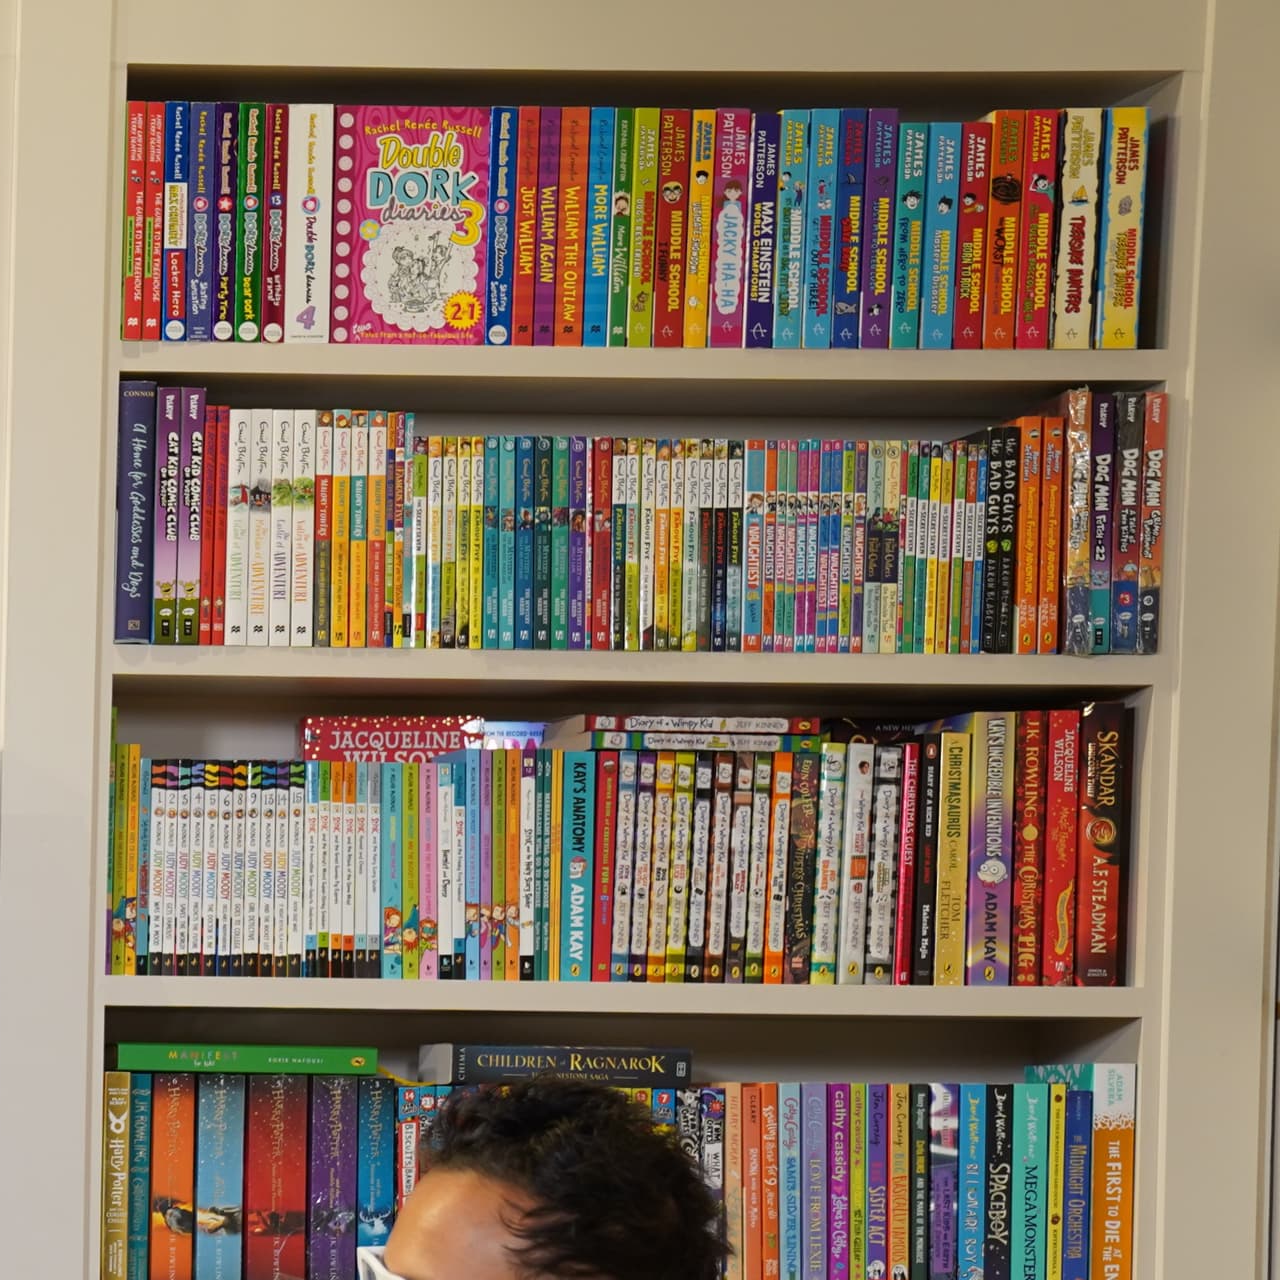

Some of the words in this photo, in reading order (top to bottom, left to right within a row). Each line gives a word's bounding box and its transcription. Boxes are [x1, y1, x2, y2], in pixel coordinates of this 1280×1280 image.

[378, 134, 461, 168] Double
[370, 171, 476, 207] DORK
[383, 199, 464, 221] diaries
[761, 202, 773, 234] MAX
[1036, 213, 1049, 259] MIDDLE
[171, 252, 179, 288] Locker
[564, 243, 578, 266] THE
[758, 238, 772, 303] EINSTEIN
[562, 271, 576, 321] OUTLAW
[1035, 263, 1047, 310] SCHOOL
[172, 291, 180, 316] Hero
[133, 423, 147, 432] A
[132, 438, 148, 469] Home
[1005, 438, 1016, 455] the
[128, 472, 147, 488] for
[1004, 460, 1016, 490] BAD
[1094, 454, 1111, 482] DOG
[1001, 493, 1015, 533] GUYS
[1095, 484, 1110, 511] MAN
[130, 492, 147, 544] Goddesses
[731, 512, 739, 544] FAMOUS
[130, 546, 143, 569] and
[731, 546, 739, 564] FIVE
[747, 526, 760, 586] NAUGHTIEST
[122, 571, 142, 598] Dogs
[329, 730, 460, 750] JACQUELINE
[573, 762, 587, 794] KAY'S
[908, 758, 916, 777] THE
[905, 779, 916, 834] CHRISTMAS
[572, 797, 587, 853] ANATOMY
[904, 836, 914, 866] GUEST
[570, 883, 585, 928] ADAM
[1091, 880, 1107, 953] STEADMAN
[570, 931, 584, 961] KAY
[476, 1054, 558, 1070] CHILDREN
[568, 1054, 666, 1074] RAGNAROK
[831, 1091, 847, 1128] cathy
[109, 1139, 125, 1171] Harry
[831, 1131, 847, 1182] cassidy
[1107, 1140, 1121, 1159] THE
[110, 1173, 127, 1207] Potter
[1105, 1162, 1122, 1202] FIRST
[987, 1163, 1010, 1246] SPACEBOY
[1106, 1205, 1117, 1217] TO
[1103, 1219, 1121, 1243] DIE
